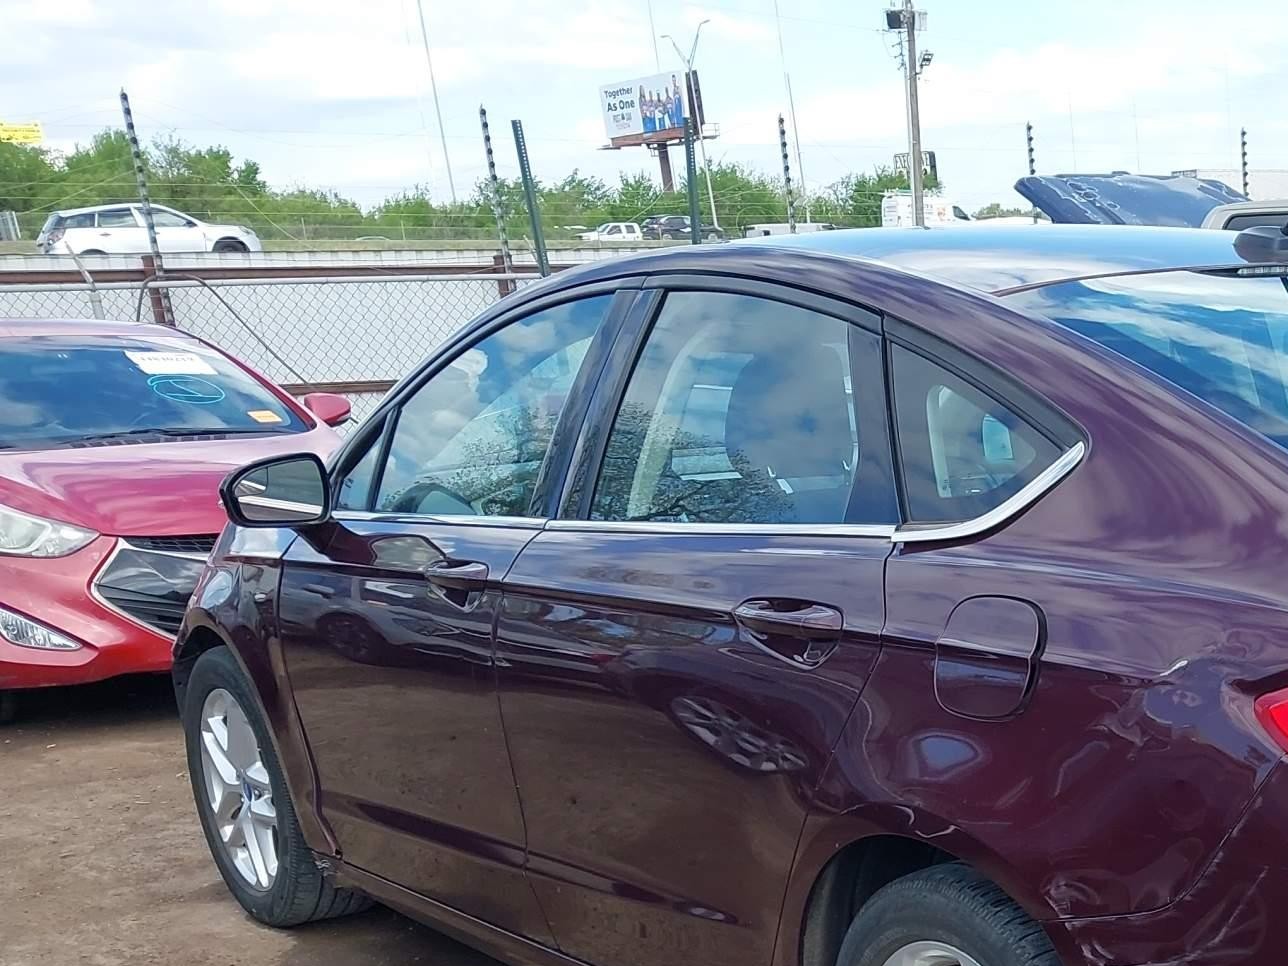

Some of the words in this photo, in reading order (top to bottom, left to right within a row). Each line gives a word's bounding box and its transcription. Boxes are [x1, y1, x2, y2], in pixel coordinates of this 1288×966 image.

[603, 87, 632, 99] Together
[607, 102, 617, 112] As
[619, 100, 635, 110] One
